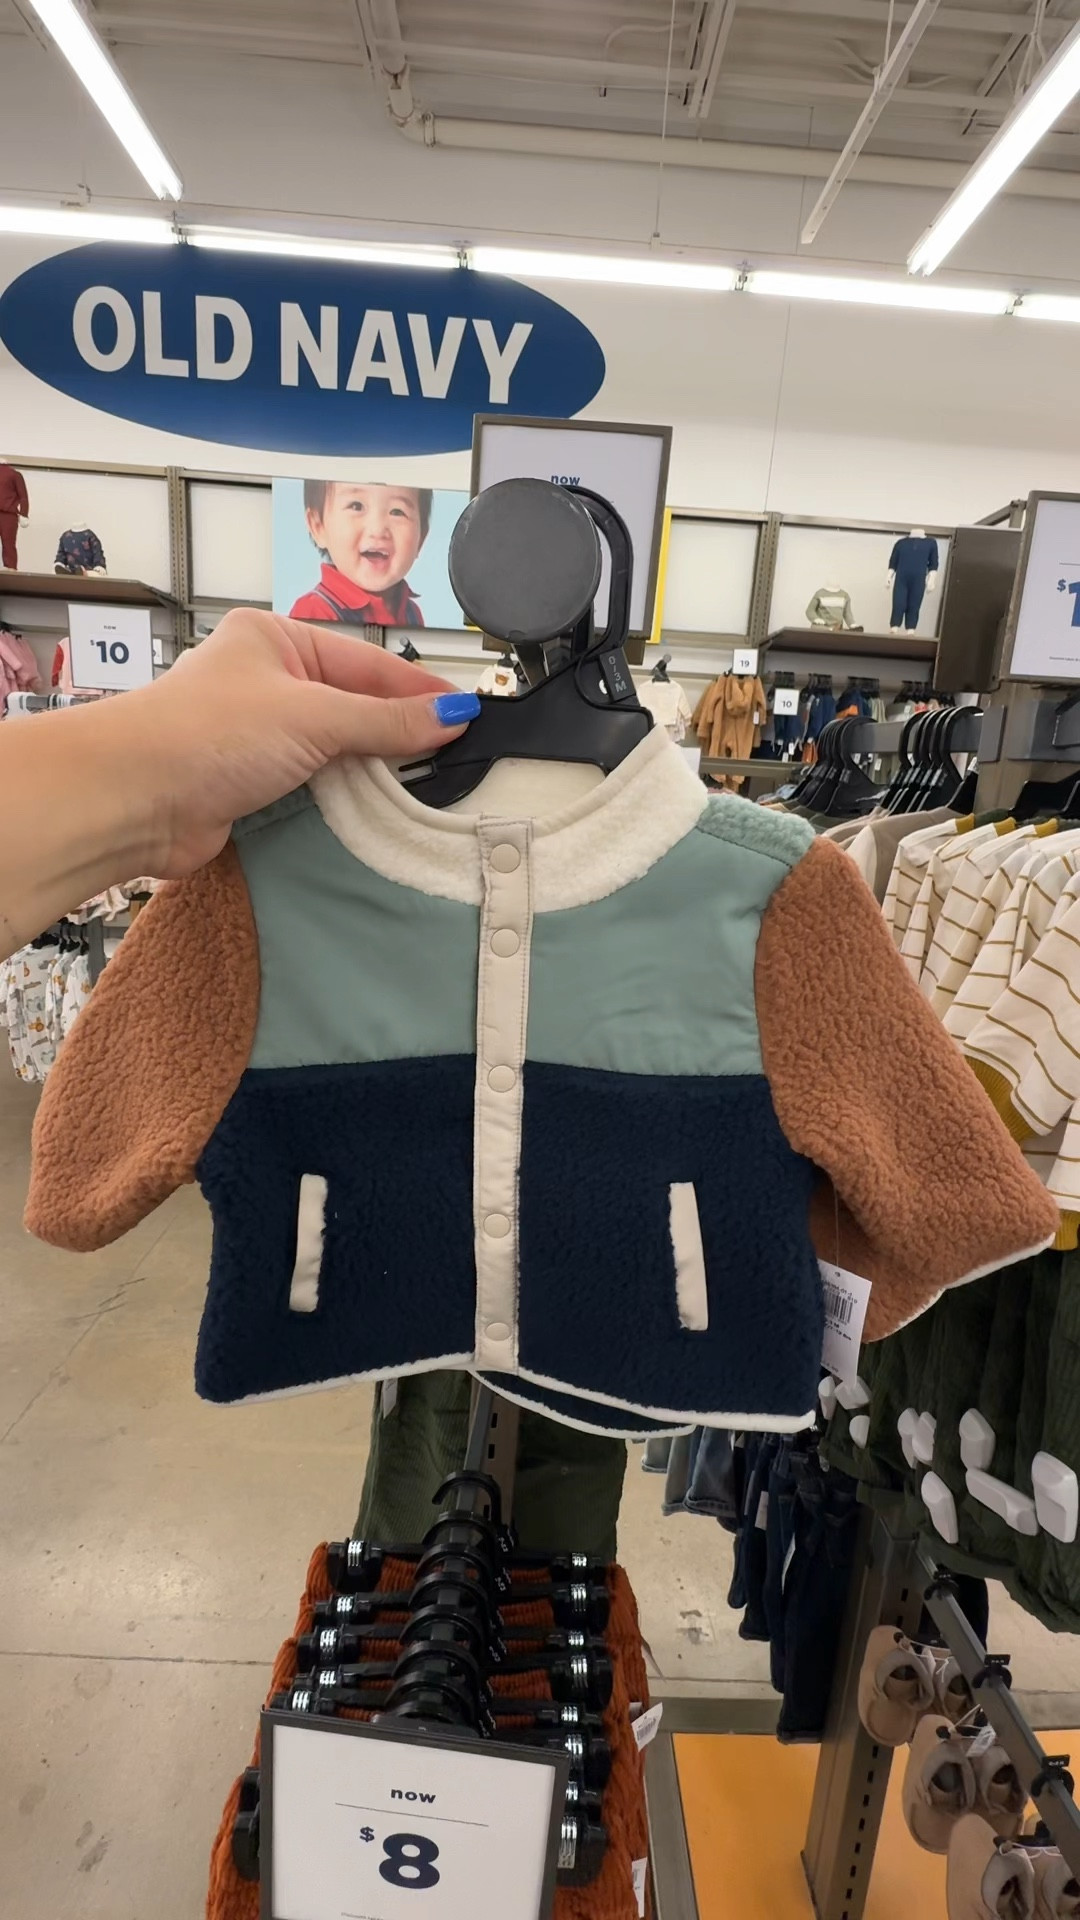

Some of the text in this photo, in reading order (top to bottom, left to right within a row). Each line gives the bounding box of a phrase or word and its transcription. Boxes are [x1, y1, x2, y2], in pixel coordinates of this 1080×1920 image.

[72, 285, 534, 405] OLD NAVY
[551, 475, 580, 485] now
[90, 640, 129, 664] $10
[740, 660, 750, 668] 19
[782, 700, 793, 708] 10
[391, 1788, 436, 1803] now
[359, 1826, 440, 1889] $8
